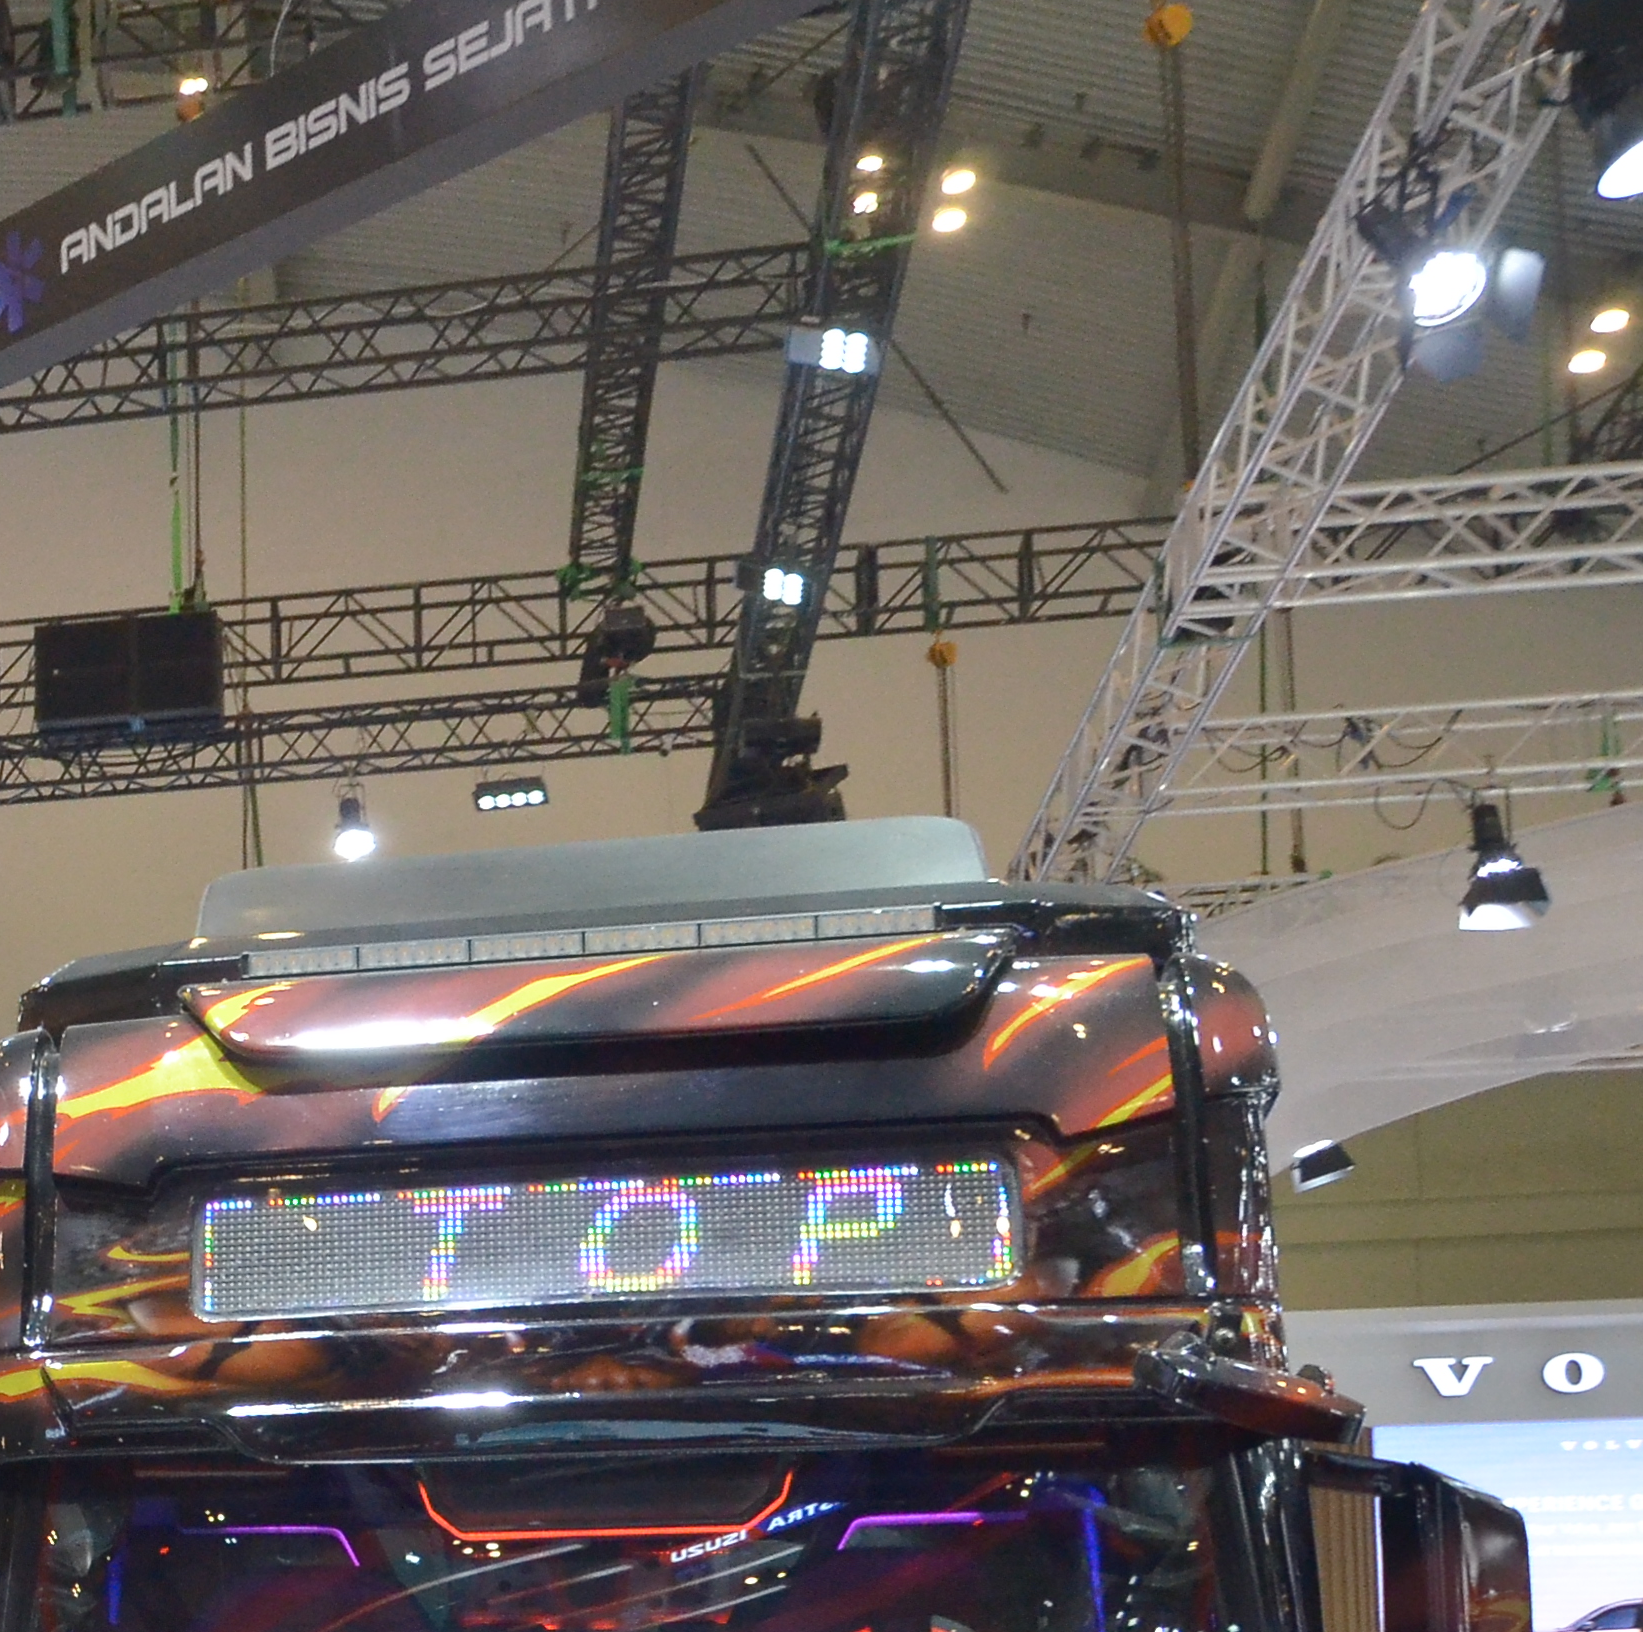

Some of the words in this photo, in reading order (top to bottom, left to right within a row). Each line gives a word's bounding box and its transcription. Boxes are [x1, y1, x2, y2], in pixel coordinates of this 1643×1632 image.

[60, 139, 256, 275] ANDALAN
[265, 62, 411, 166] BISNIS
[425, 0, 599, 91] SEJA
[411, 1172, 905, 1303] TOP
